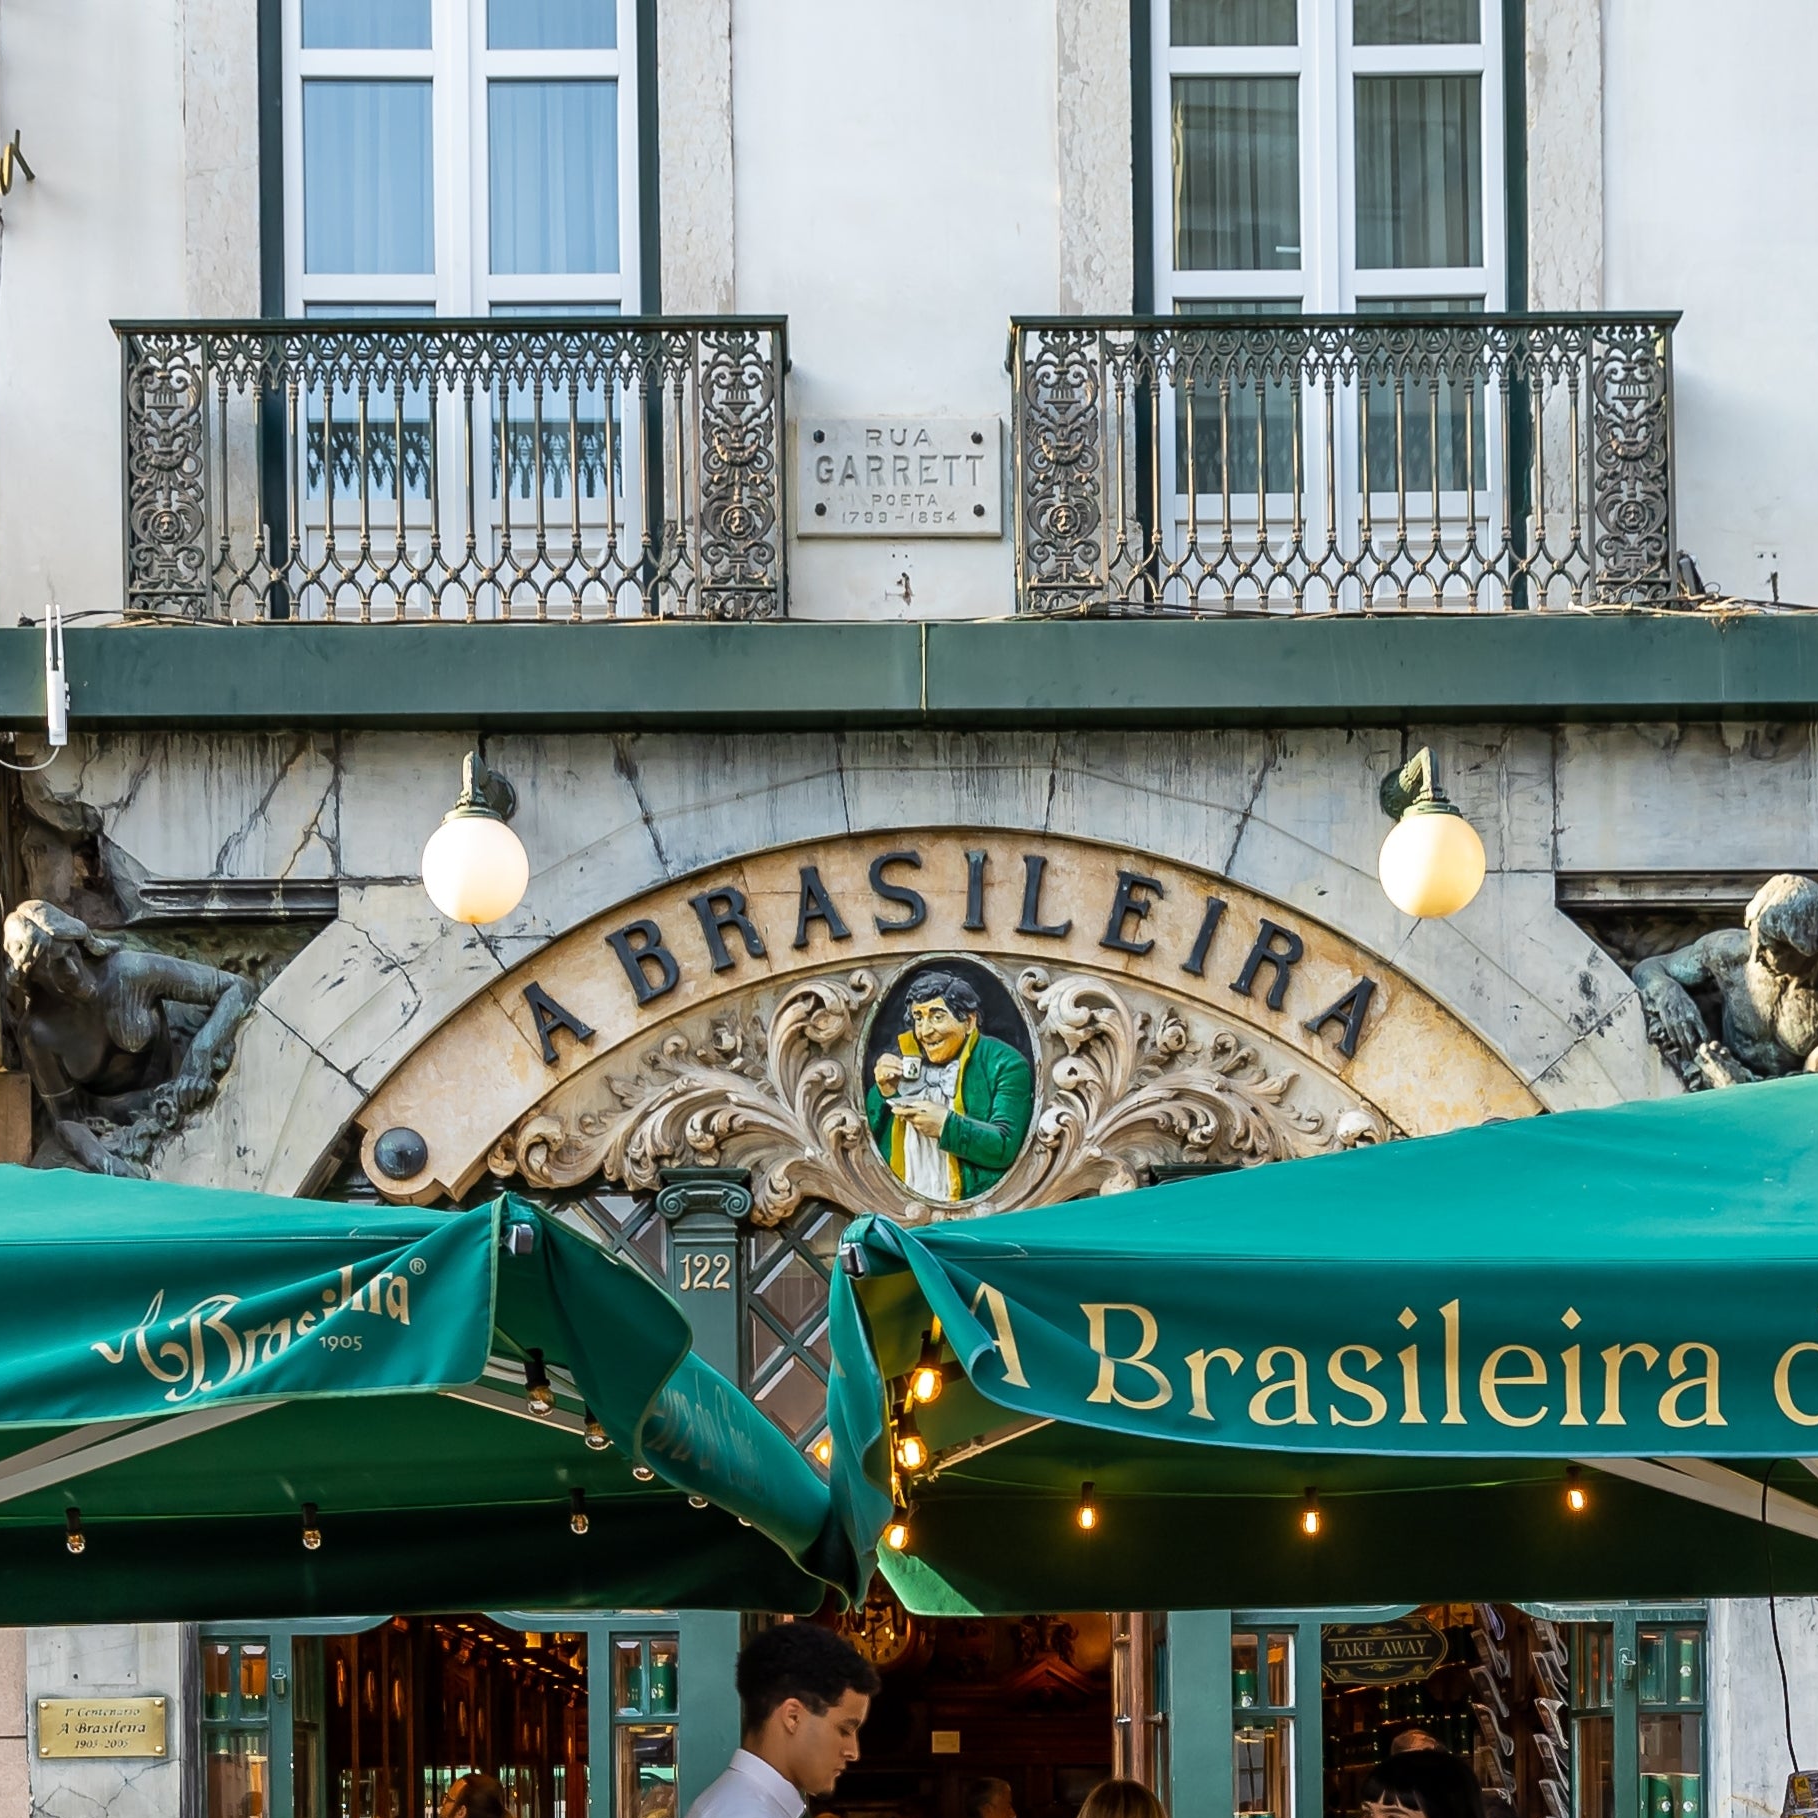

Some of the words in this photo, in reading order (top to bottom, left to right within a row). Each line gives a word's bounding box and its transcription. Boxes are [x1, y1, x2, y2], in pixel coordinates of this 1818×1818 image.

[865, 428, 933, 447] RUA
[814, 455, 985, 486] GARRETT
[872, 494, 938, 506] POETA
[521, 980, 596, 1066] A
[605, 850, 1378, 1059] BRASILEIRA
[678, 1254, 731, 1291] 122
[318, 1336, 363, 1352] 1905
[970, 1281, 1031, 1389] A
[1079, 1298, 1728, 1427] Brasileira
[1331, 1641, 1375, 1657] TAKE
[1381, 1639, 1426, 1655] AWAY
[57, 1722, 69, 1735] A
[75, 1720, 146, 1734] Brasileira
